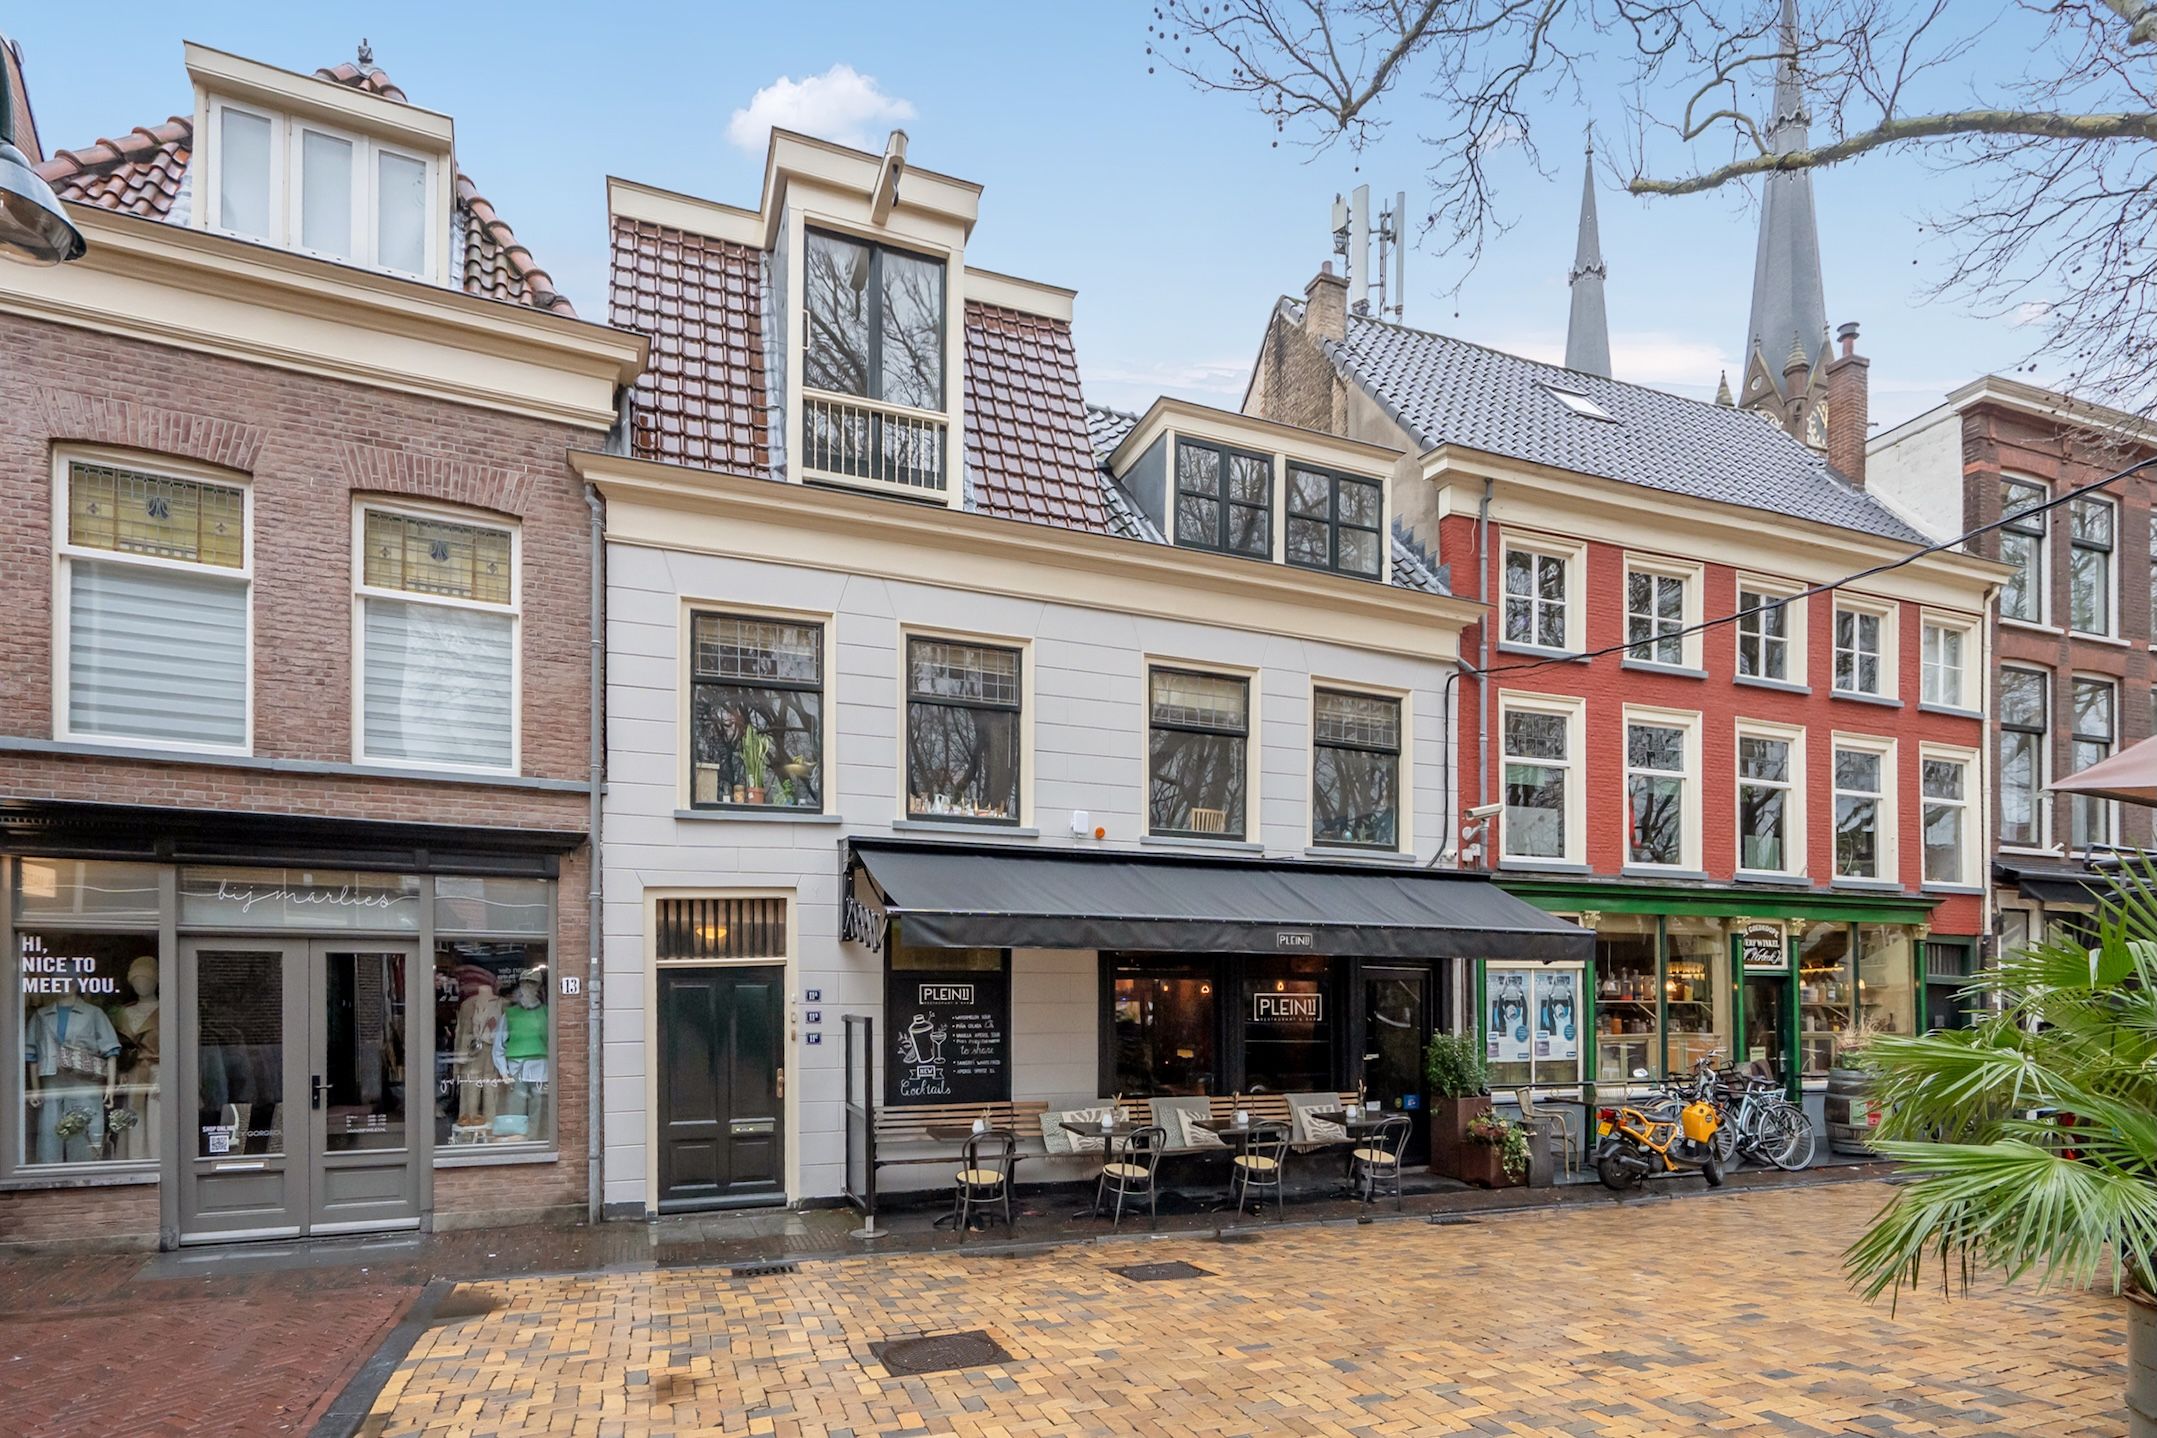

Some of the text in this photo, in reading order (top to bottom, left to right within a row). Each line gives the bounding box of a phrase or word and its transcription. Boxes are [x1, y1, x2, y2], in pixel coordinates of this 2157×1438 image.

[219, 878, 396, 913] bij marlies
[22, 936, 48, 954] HI,
[22, 957, 96, 973] NICE TO
[22, 978, 120, 993] MEET YOU.
[565, 979, 578, 993] 13
[924, 988, 970, 1001] PLEIN11
[1260, 999, 1316, 1016] PLEIN11
[960, 1042, 994, 1055] to share
[900, 1079, 952, 1096] Cocktails
